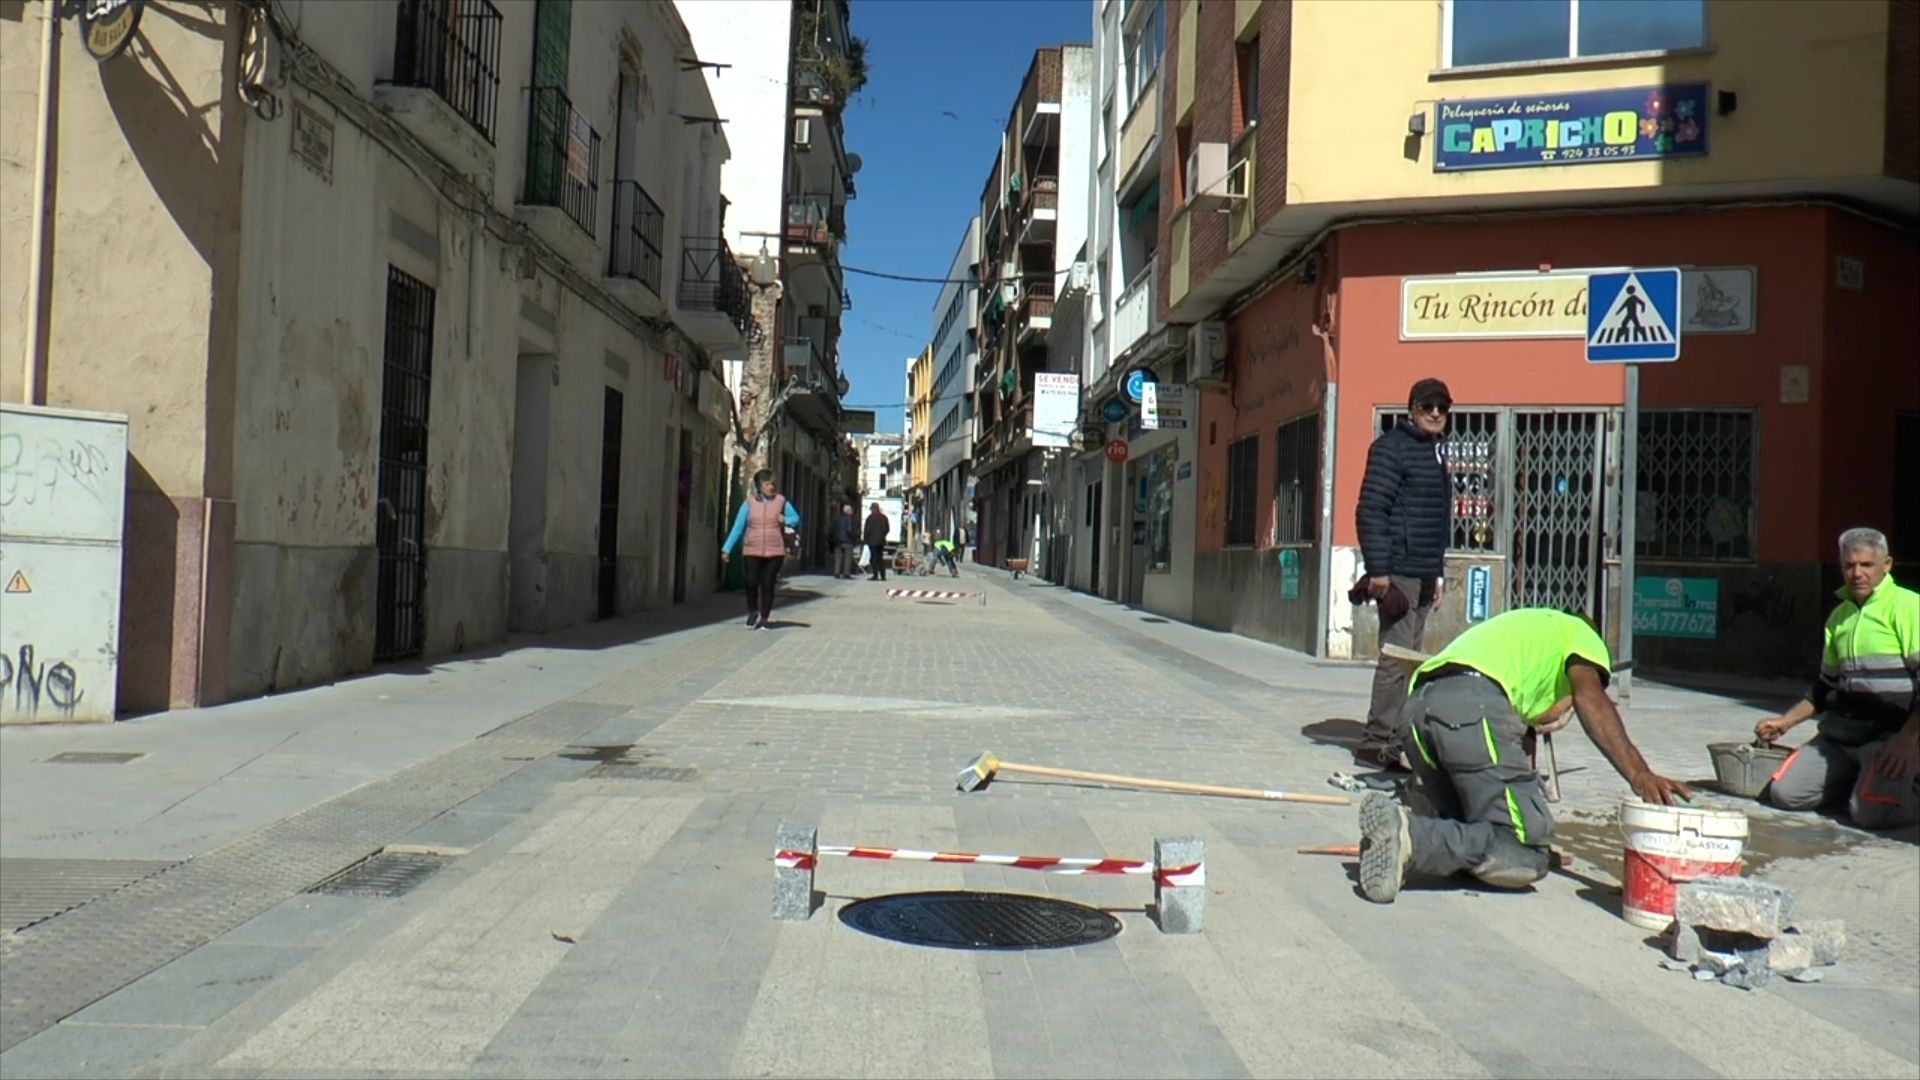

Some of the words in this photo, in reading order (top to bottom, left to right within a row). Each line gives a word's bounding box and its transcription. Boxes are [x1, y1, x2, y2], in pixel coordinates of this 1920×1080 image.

[1442, 104, 1504, 121] Peluquería
[1507, 100, 1521, 115] de
[1525, 101, 1570, 113] señoras
[1442, 111, 1637, 153] CAPRICHO
[1561, 148, 1584, 158] 924
[1586, 147, 1600, 157] 33
[1603, 146, 1618, 156] 05
[1414, 293, 1450, 320] Tu
[1459, 291, 1555, 323] Rincón
[1038, 374, 1049, 383] SE
